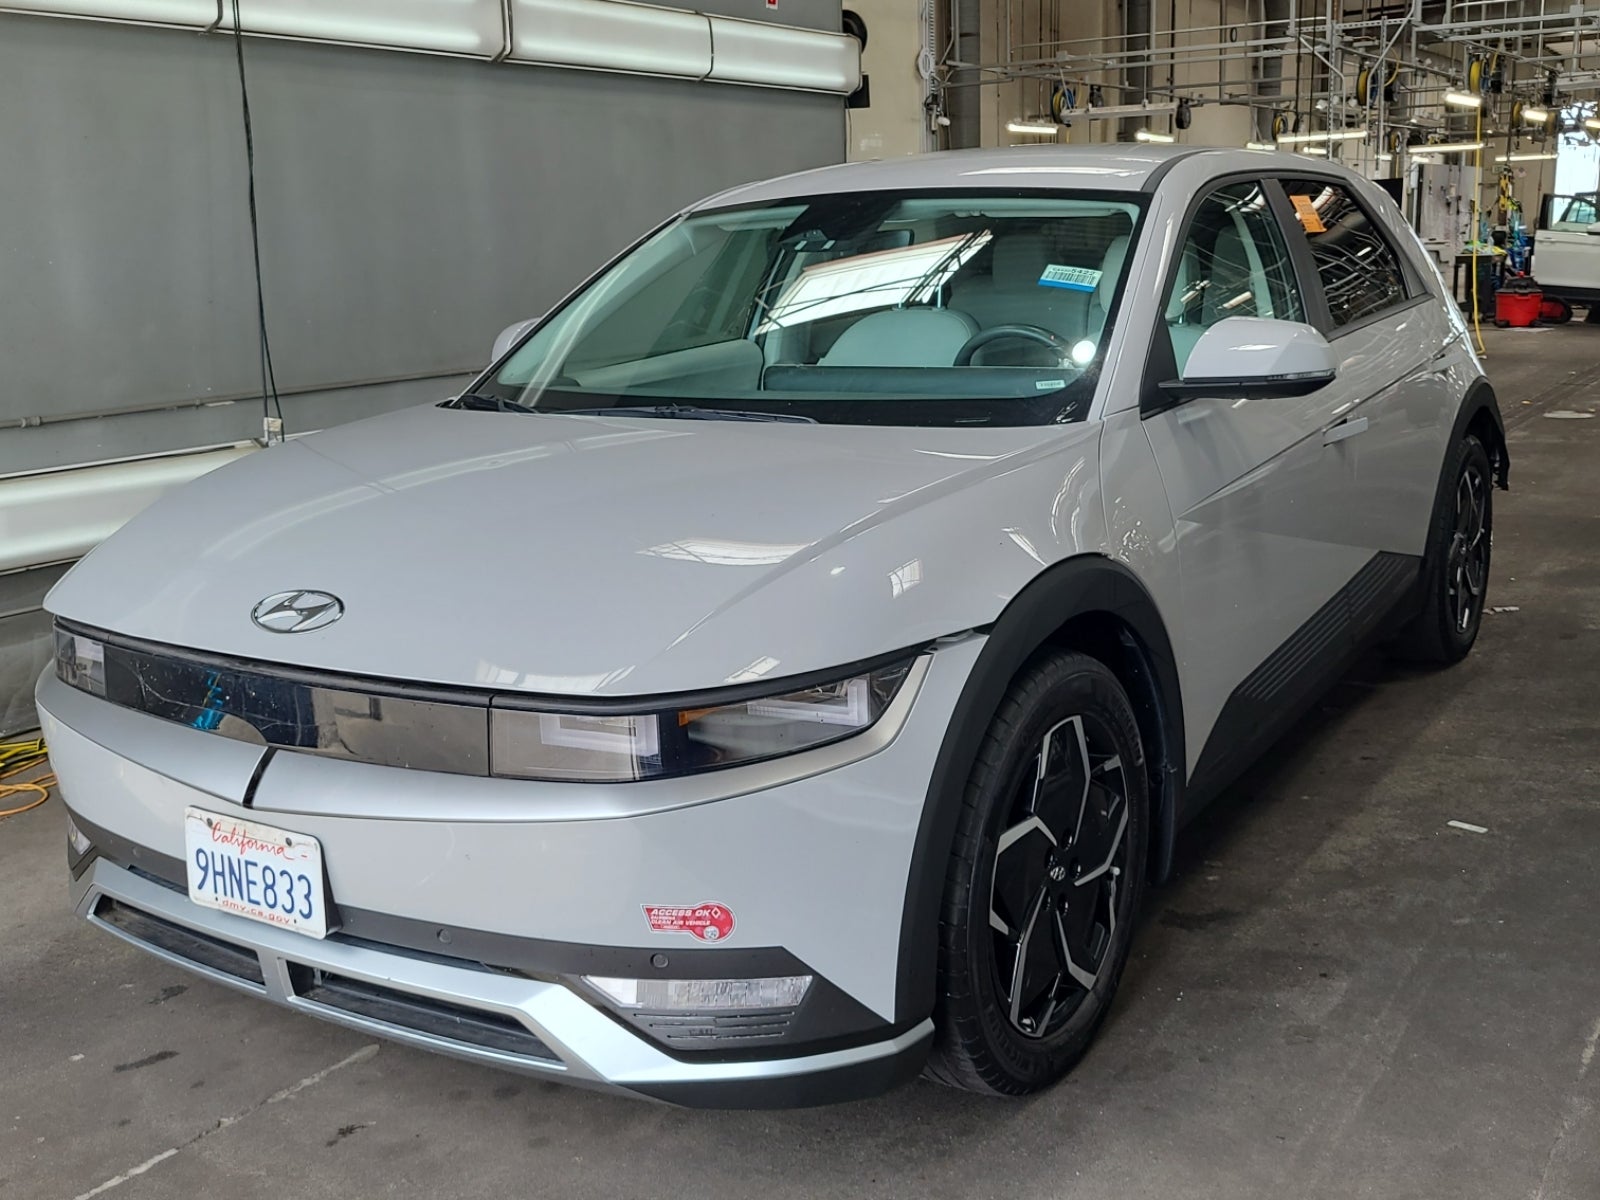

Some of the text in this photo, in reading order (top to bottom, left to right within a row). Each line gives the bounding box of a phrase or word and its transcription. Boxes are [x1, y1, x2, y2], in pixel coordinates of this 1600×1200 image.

[211, 821, 295, 861] California
[195, 847, 313, 920] 9HNE833
[222, 900, 291, 925] dmv.ca.gov
[650, 908, 711, 917] ACCESS OK
